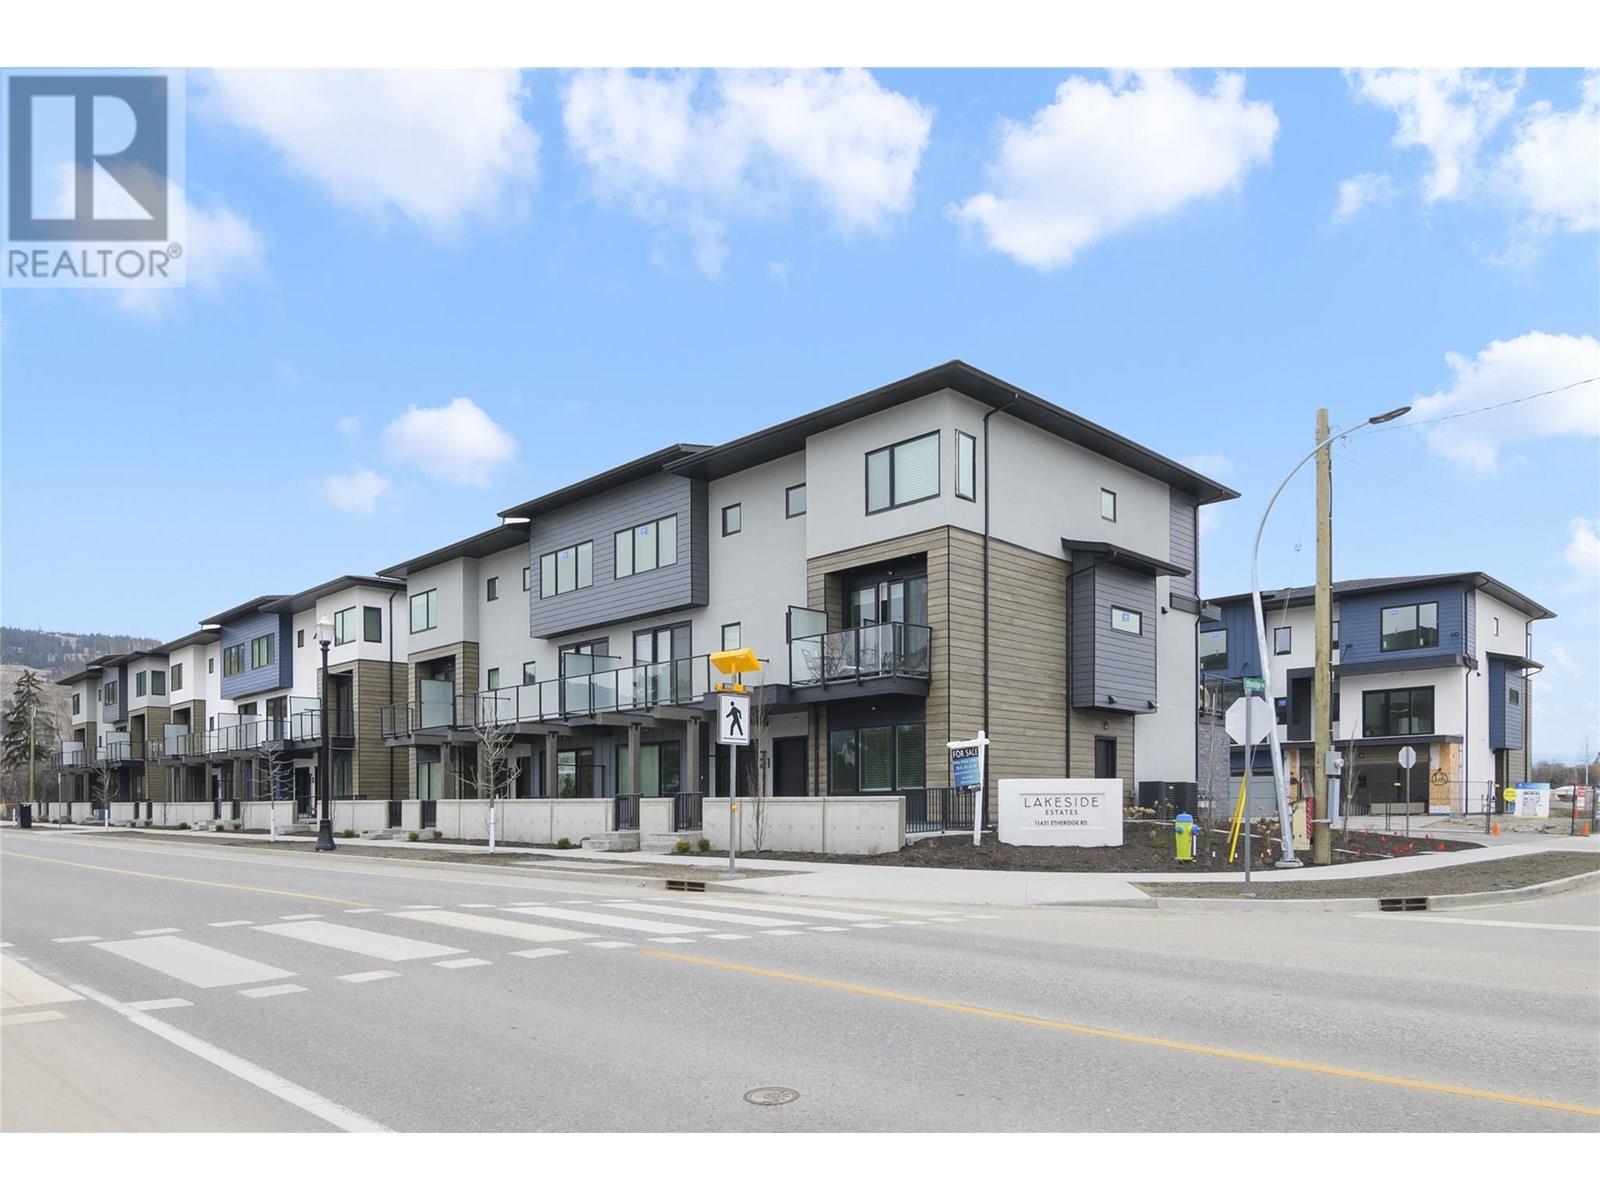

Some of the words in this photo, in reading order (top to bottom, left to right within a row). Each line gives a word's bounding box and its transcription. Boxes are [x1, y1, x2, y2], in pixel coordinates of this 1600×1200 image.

[953, 750, 965, 758] FOR
[966, 748, 978, 756] SALE
[1024, 796, 1099, 808] LAKESIDE
